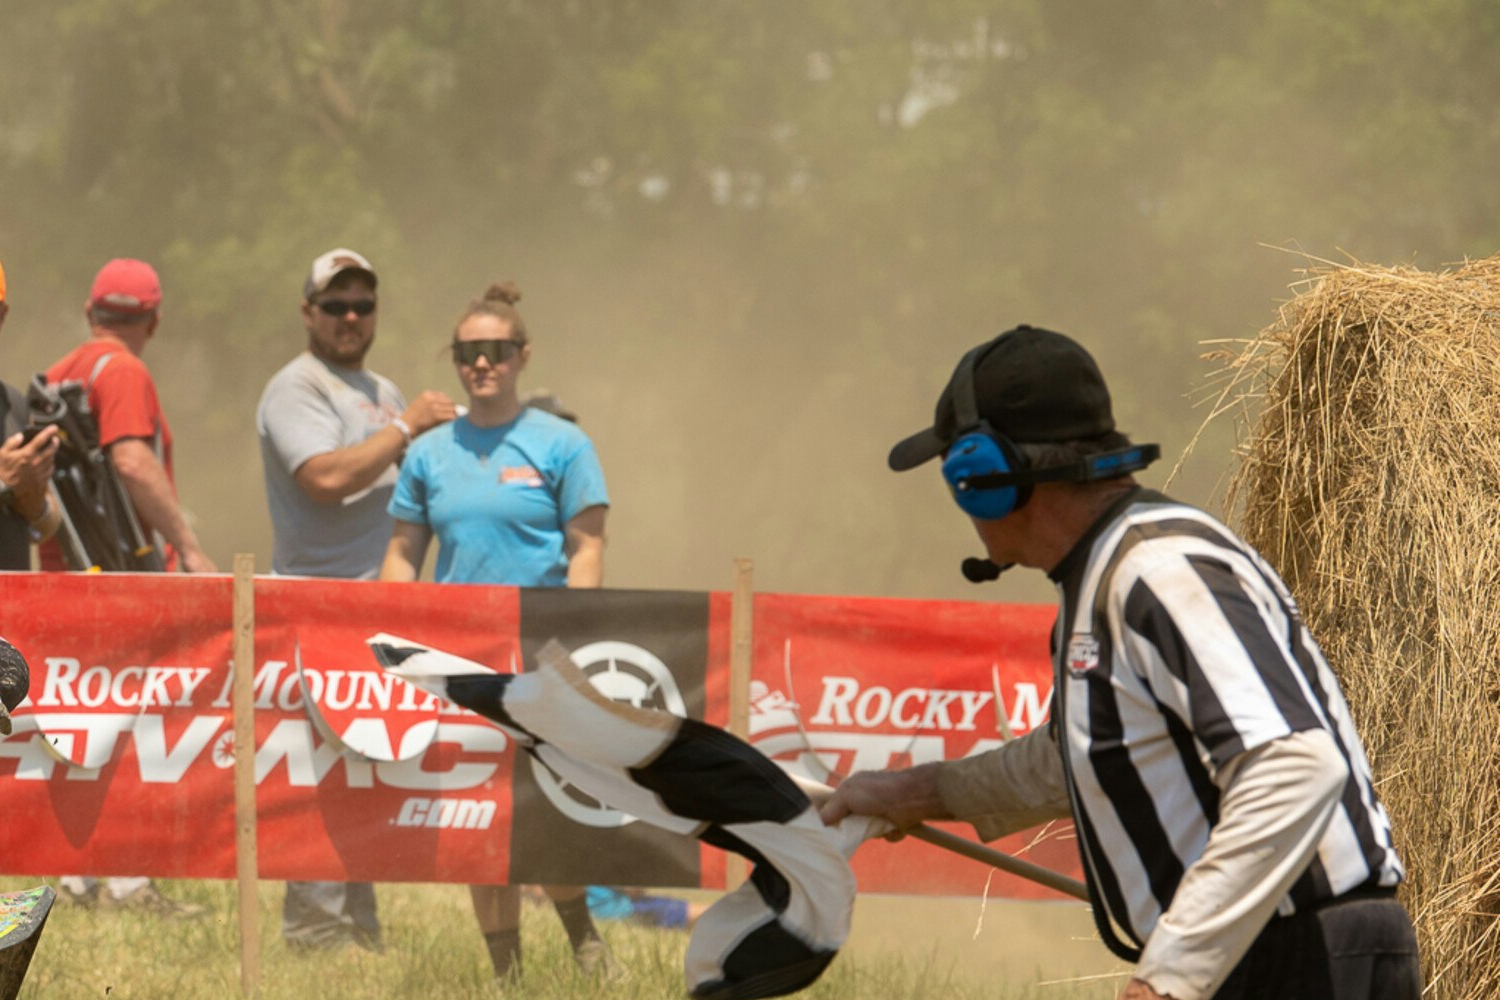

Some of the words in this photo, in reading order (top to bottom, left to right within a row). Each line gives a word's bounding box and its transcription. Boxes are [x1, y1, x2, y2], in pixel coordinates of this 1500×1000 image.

[38, 657, 211, 708] ROCKY
[211, 660, 479, 716] MOUNT
[809, 675, 994, 732] ROCKY
